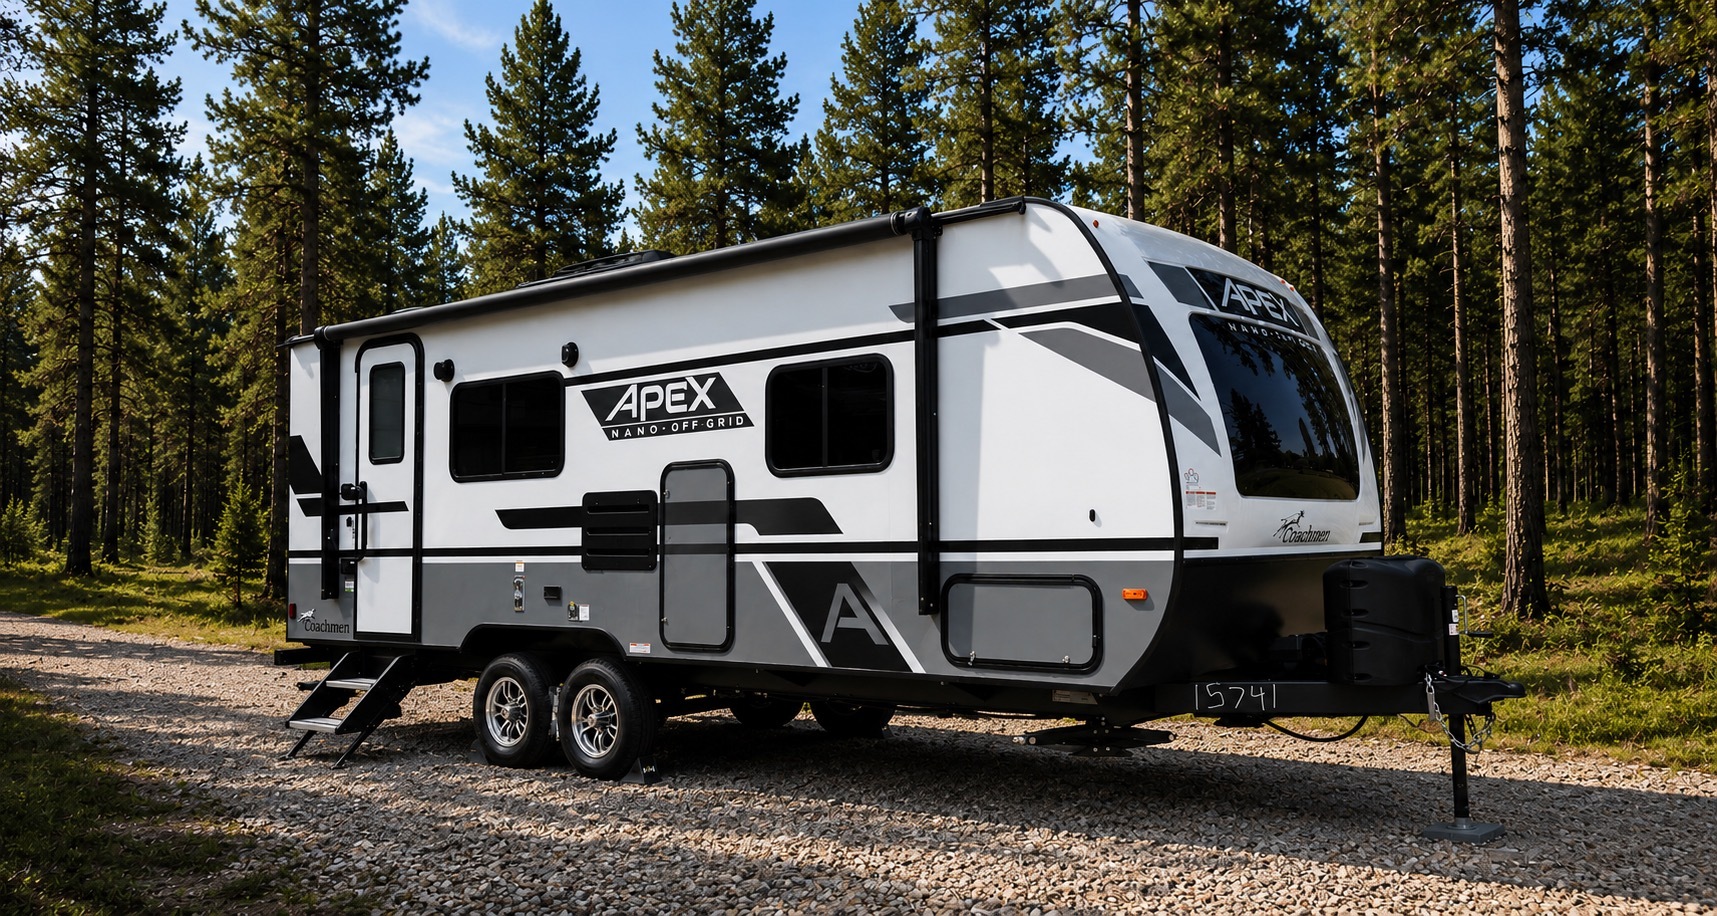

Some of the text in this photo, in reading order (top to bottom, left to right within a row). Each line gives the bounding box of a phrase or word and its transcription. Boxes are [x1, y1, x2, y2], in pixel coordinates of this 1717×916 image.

[1221, 277, 1300, 327] APEX
[604, 376, 717, 422] APEX
[611, 425, 658, 439] NANO
[1282, 525, 1331, 543] Coachmen
[304, 619, 350, 634] Coachmen
[820, 583, 889, 645] A
[1194, 682, 1277, 711] 15741
